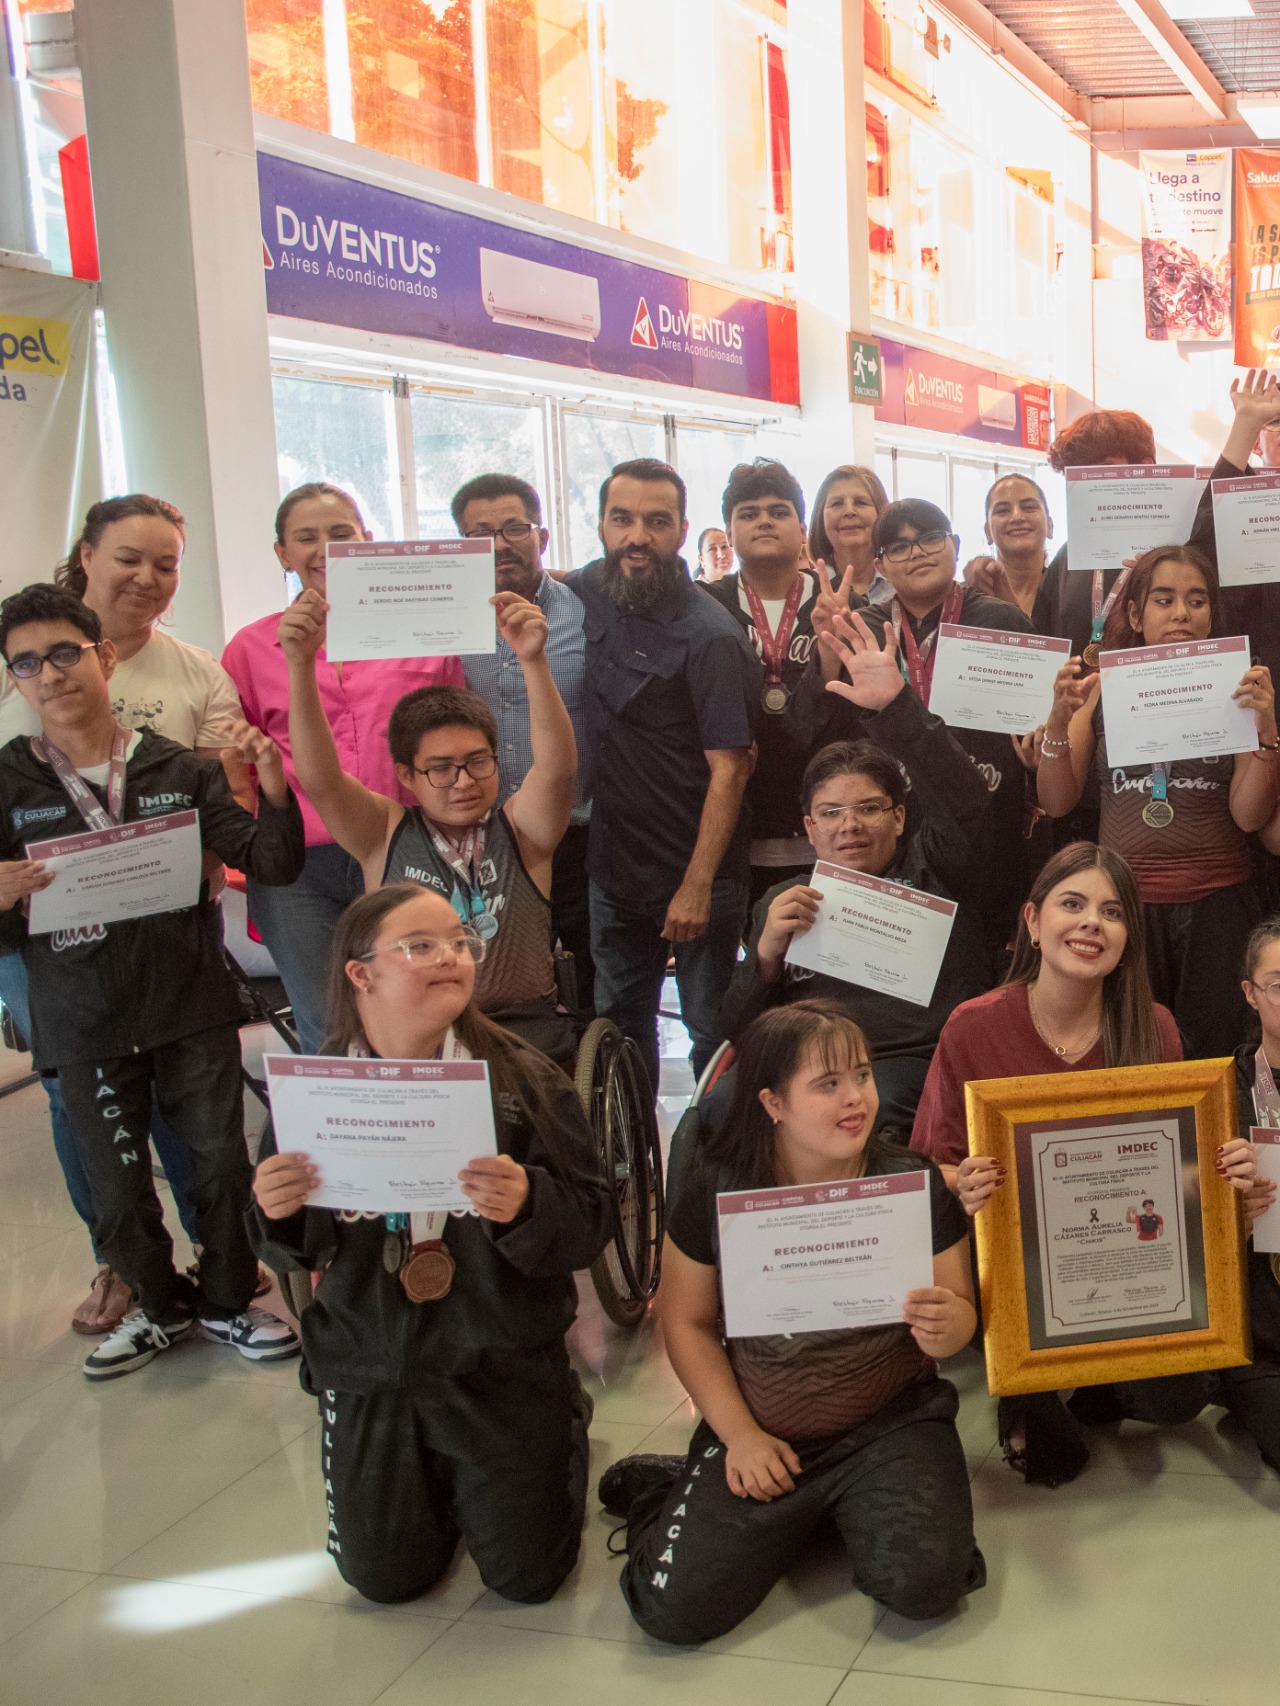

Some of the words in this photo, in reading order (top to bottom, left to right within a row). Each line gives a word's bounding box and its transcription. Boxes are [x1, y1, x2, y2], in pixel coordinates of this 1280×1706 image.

[1192, 174, 1199, 183] a
[280, 251, 320, 275] Aires
[326, 261, 438, 299] Acondicionados
[661, 336, 682, 352] Aires
[685, 342, 743, 365] Acondicionados
[1098, 504, 1163, 512] RECONOCIMIENTO
[369, 584, 452, 592] RECONOCIMIENTO
[1197, 643, 1219, 651] IMDEC
[968, 665, 1034, 679] RECONOCIMIENTO
[1139, 683, 1213, 699] RECONOCIMIENTO
[139, 793, 192, 808] IMDEC
[121, 829, 137, 837] DIF
[78, 860, 160, 883] RECONOCIMIENTO
[889, 887, 903, 896] DIF
[910, 893, 930, 904] IMDEC
[842, 907, 911, 935] RECONOCIMIENTO
[380, 1067, 400, 1077] DIF
[412, 1066, 445, 1074] IMDEC
[326, 1117, 436, 1128] RECONOCIMIENTO
[316, 1132, 327, 1140] A:
[1117, 1142, 1158, 1154] IMDEC
[829, 1187, 849, 1198] DIF
[860, 1181, 889, 1192] IMDEC
[1074, 1191, 1139, 1203] RECONOCIMIENTO
[775, 1237, 879, 1256] RECONOCIMIENTO
[762, 1264, 774, 1272] A:
[780, 1261, 808, 1270] CINTHYA
[809, 1257, 843, 1267] GUTIÉRREZ
[845, 1254, 872, 1263] BELTRÁN
